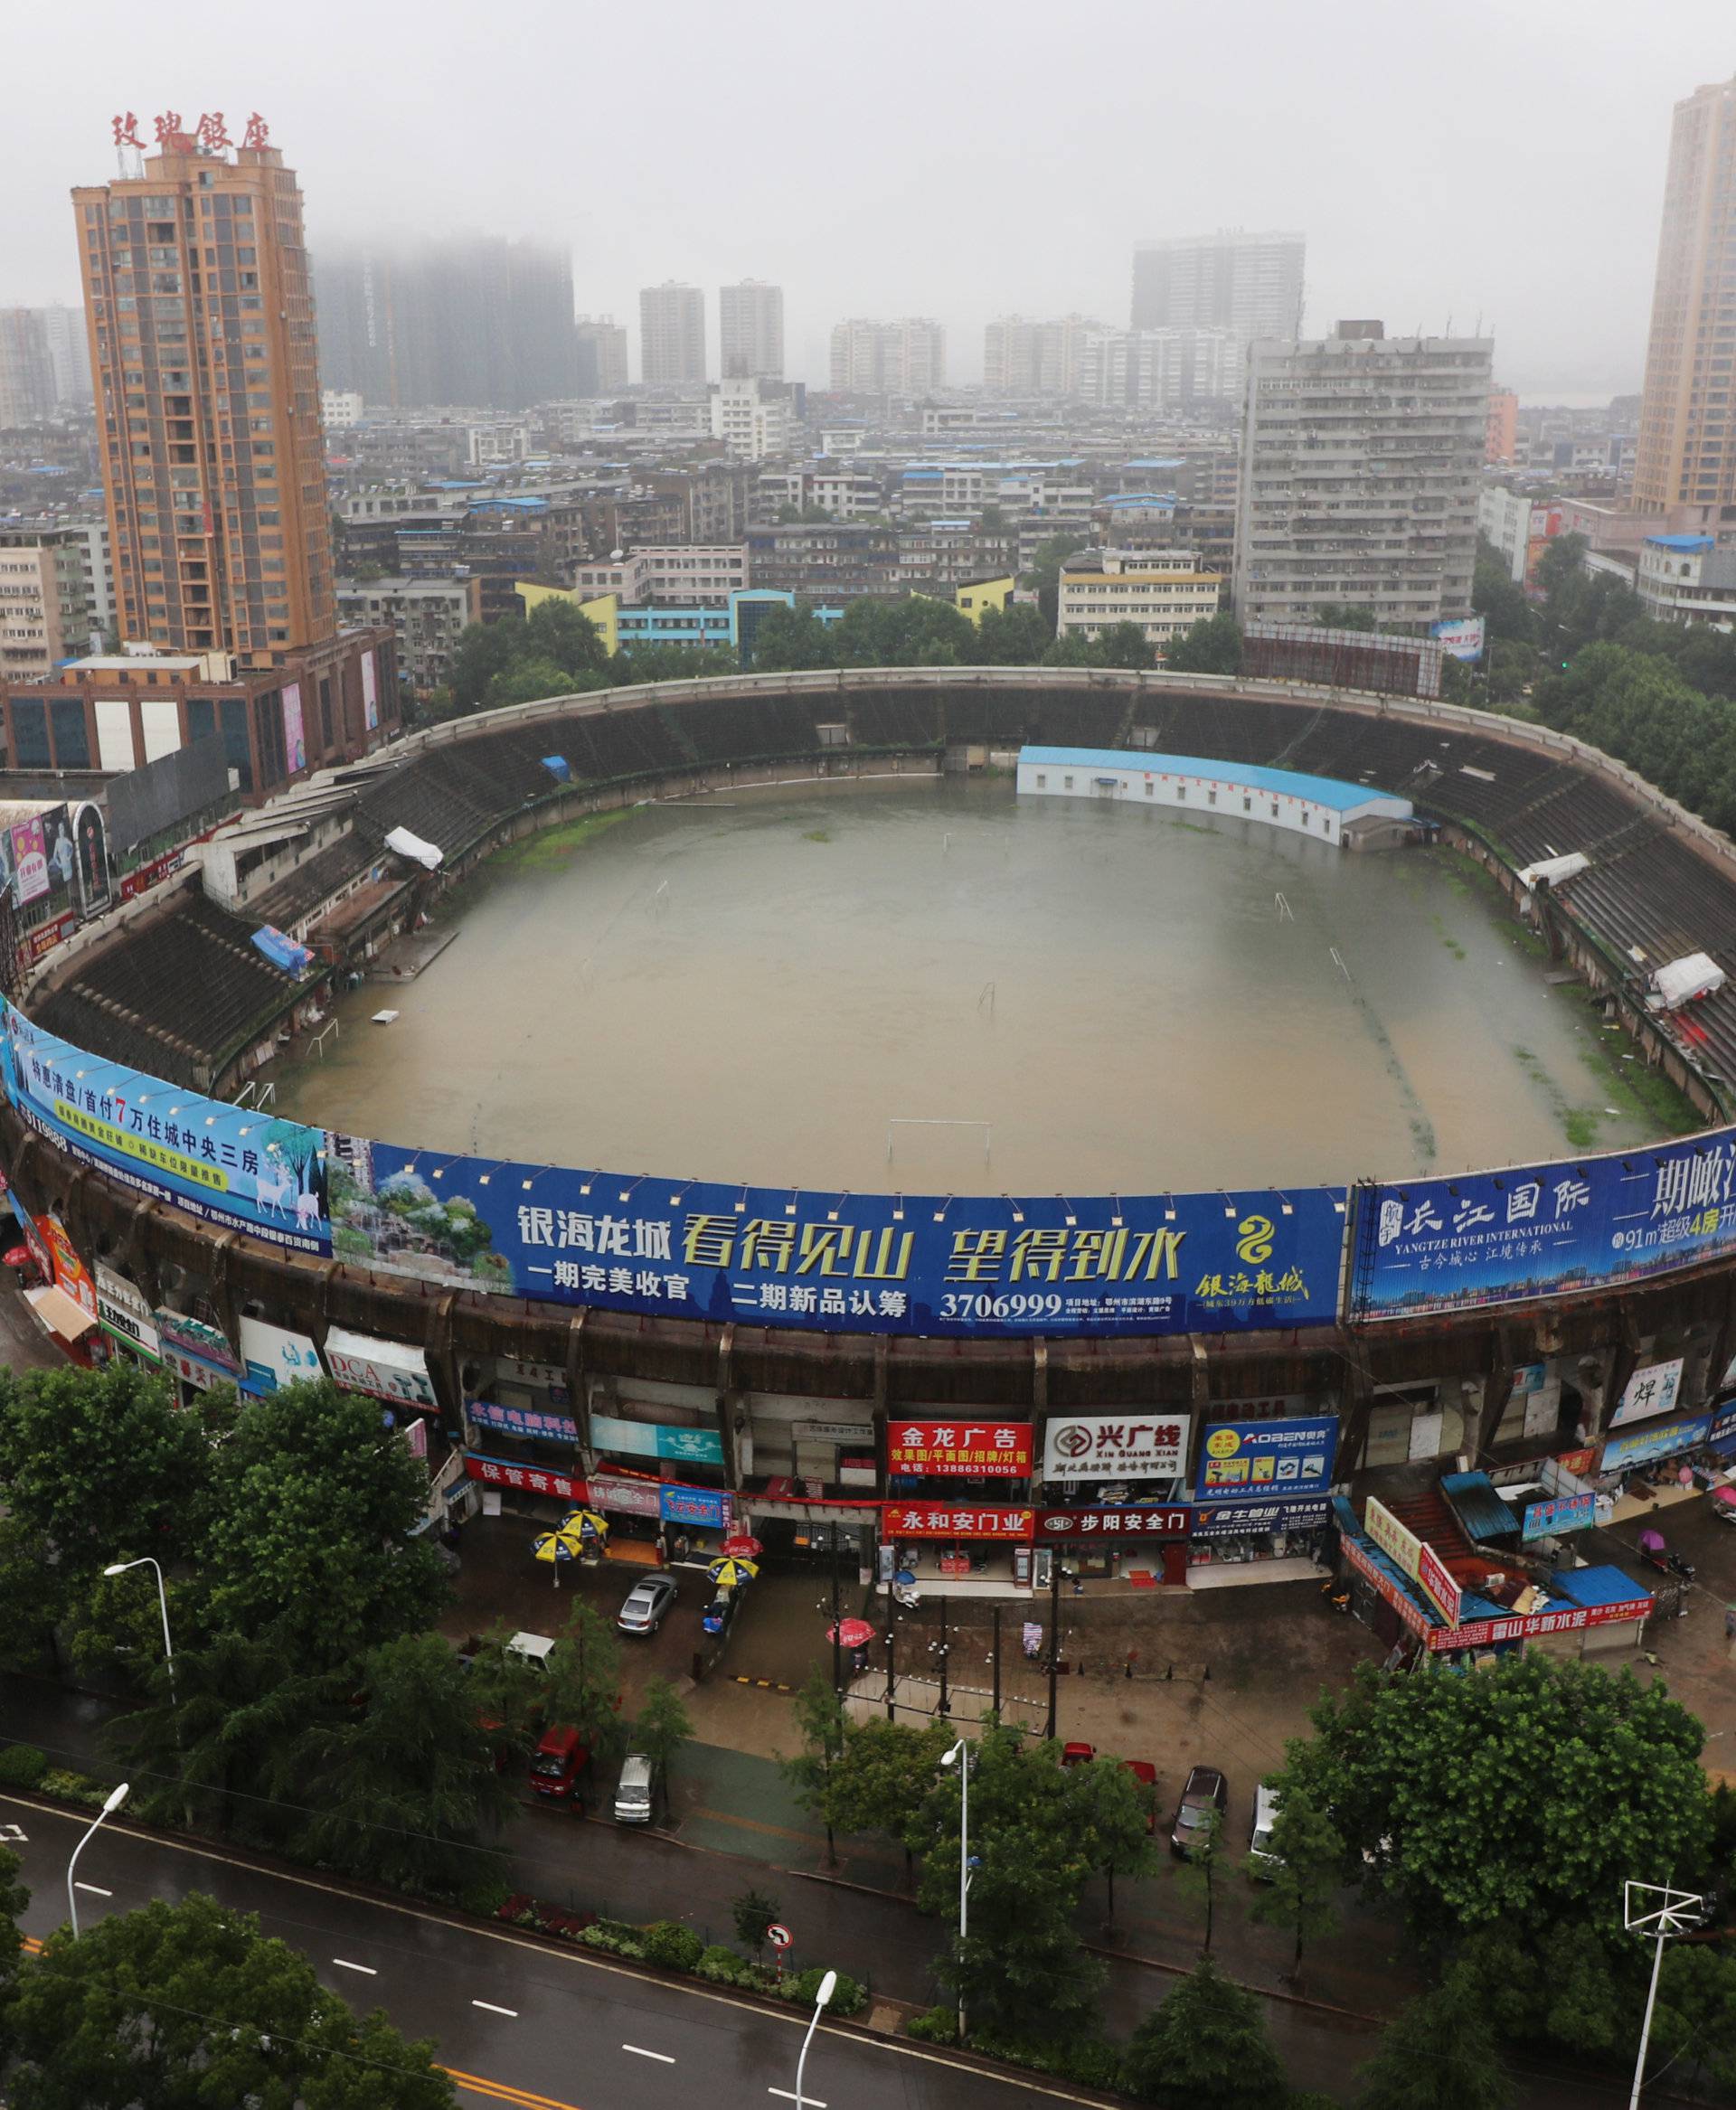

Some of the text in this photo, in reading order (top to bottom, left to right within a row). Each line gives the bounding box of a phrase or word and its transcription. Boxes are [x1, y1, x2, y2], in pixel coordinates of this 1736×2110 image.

[1402, 1180, 1590, 1235] 长江国际
[517, 1205, 1187, 1282] 银海龙城 看得见山 望得到水
[1395, 1220, 1573, 1255] YANGTZE RIVER INTERNATIONAL
[527, 1260, 908, 1318] 一期完美收官 二期新品认筹
[939, 1294, 1061, 1318] 3706999
[329, 1353, 382, 1383] DCA
[1632, 1379, 1657, 1408] 焊
[901, 1427, 1016, 1448] 金龙广告
[1242, 1432, 1306, 1445] AOBEN
[891, 1448, 1027, 1464] 效果图/平面图/招牌/灯箱
[481, 1463, 572, 1496] 保管寄售
[935, 1465, 1017, 1474] 13886310056
[902, 1511, 1024, 1532] 永和安门业
[1080, 1512, 1184, 1531] 步阳安全门
